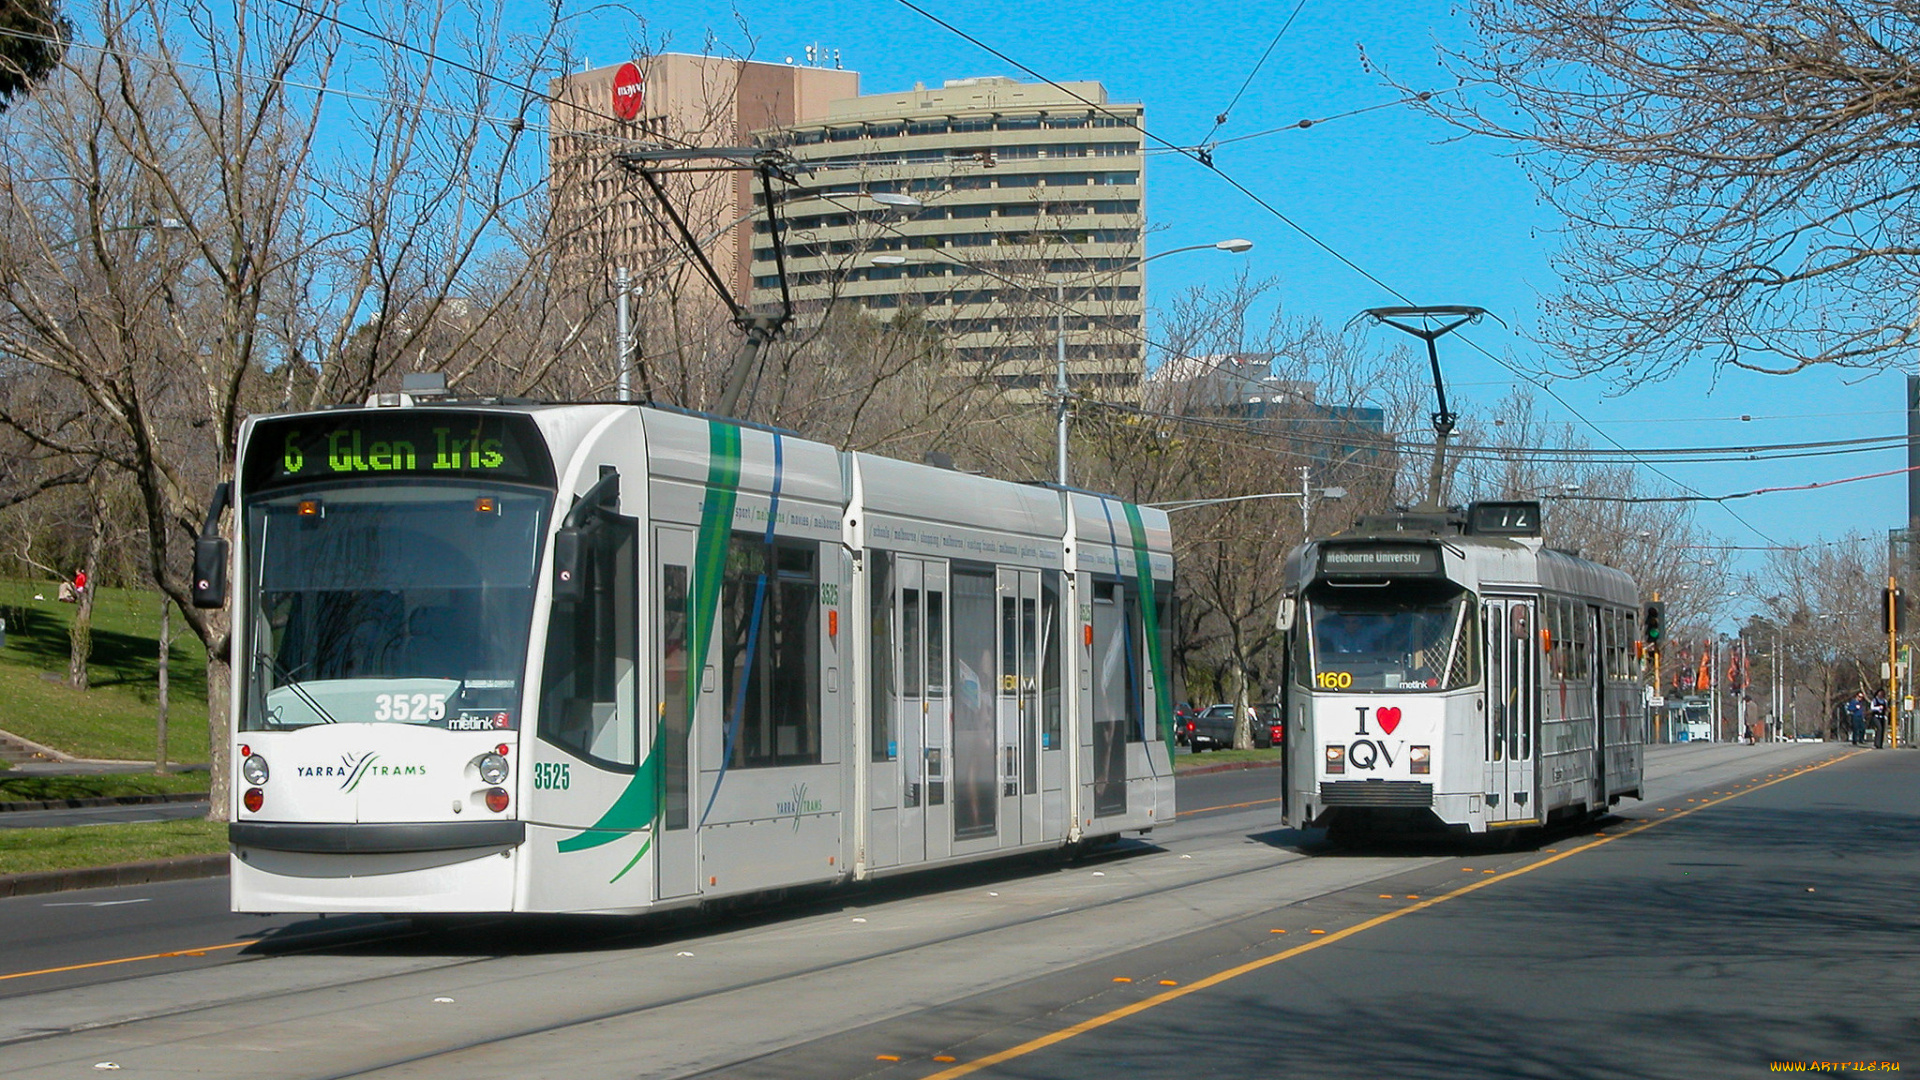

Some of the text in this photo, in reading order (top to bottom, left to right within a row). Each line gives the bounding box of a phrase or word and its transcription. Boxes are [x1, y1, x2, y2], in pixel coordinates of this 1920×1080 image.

[285, 428, 504, 472] 6 Glen Iris
[1501, 507, 1528, 527] 72
[1327, 551, 1421, 564] Melbourne University
[821, 582, 838, 606] 3525
[1316, 671, 1352, 688] 160
[1399, 680, 1428, 690] metlink
[374, 693, 446, 721] 3525
[448, 714, 494, 730] metlink
[1355, 706, 1370, 736] I
[1348, 739, 1405, 771] QV
[297, 765, 426, 777] YARRA TRAMS
[534, 762, 570, 790] 3525
